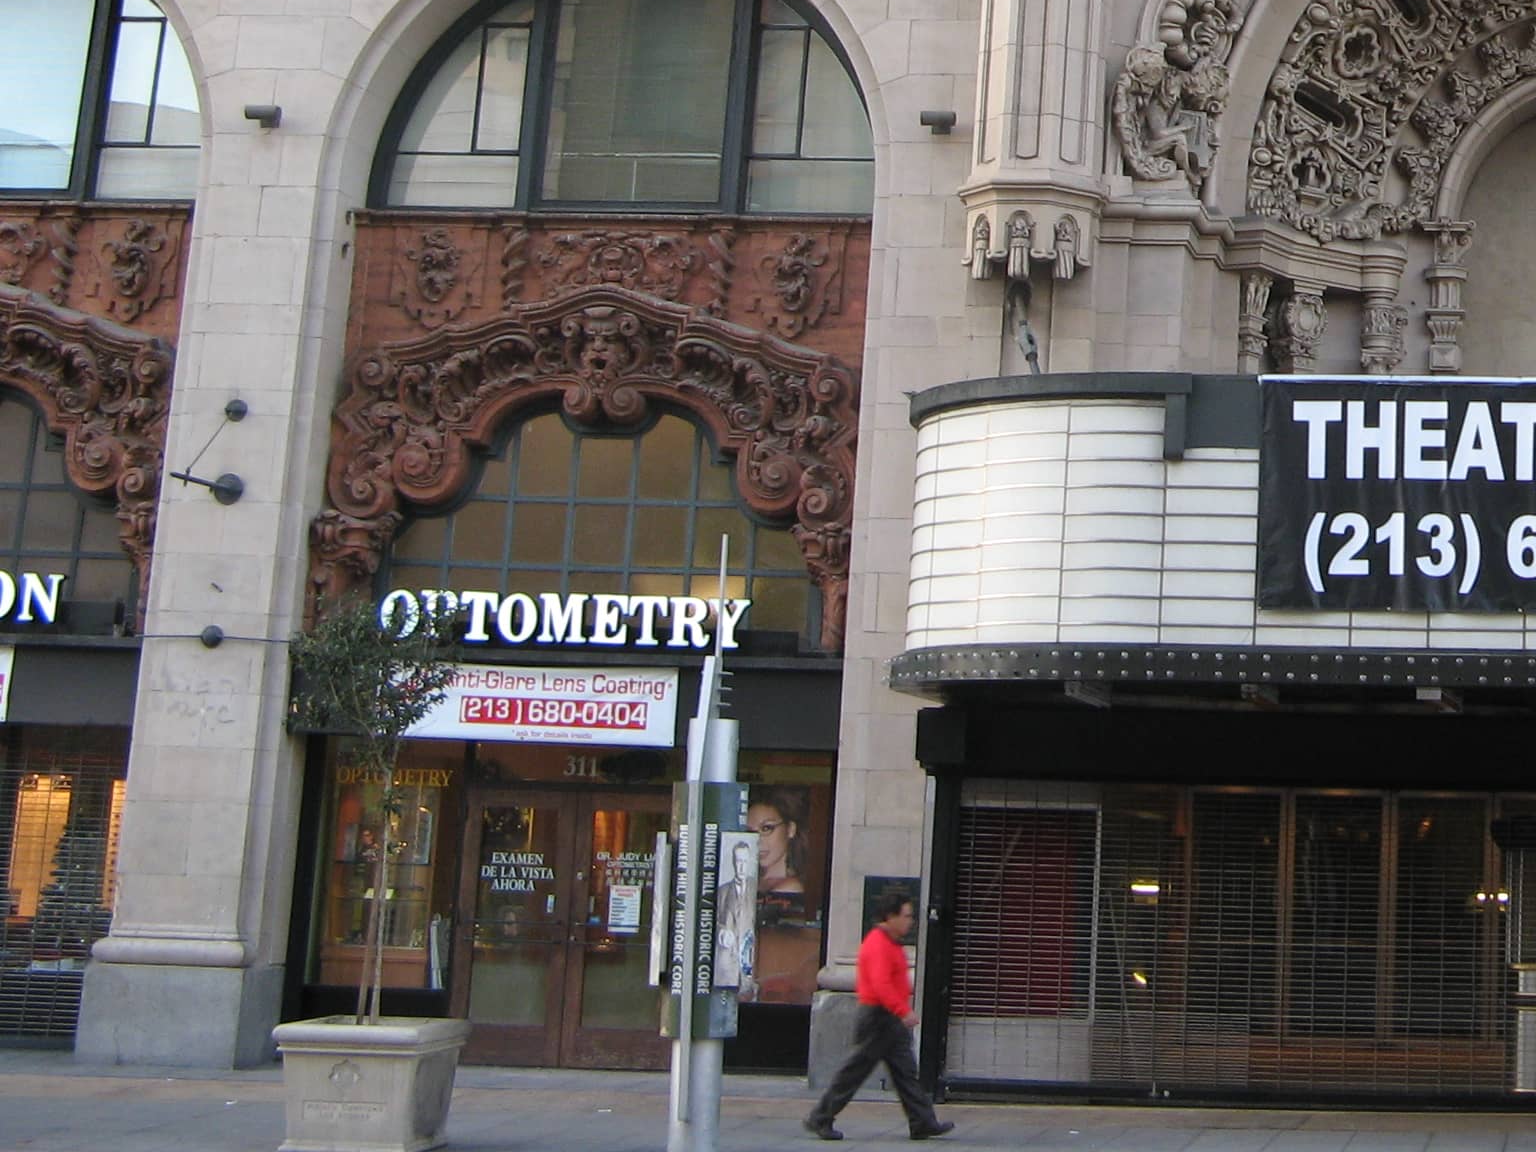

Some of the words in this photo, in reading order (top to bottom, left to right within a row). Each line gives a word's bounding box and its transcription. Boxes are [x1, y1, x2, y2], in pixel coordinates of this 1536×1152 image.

[1304, 511, 1481, 595] (213)
[379, 588, 752, 649] OPTOMETRY
[440, 668, 536, 691] nti-Glare
[541, 671, 586, 693] Lens
[528, 699, 647, 727] 680-0404
[563, 756, 598, 777] 311
[491, 851, 544, 865] EXAMEN
[678, 824, 689, 870] BUNKER
[703, 823, 718, 869] BUNKER
[481, 865, 498, 878] DE
[500, 866, 517, 879] LA
[521, 866, 554, 879] VISTA
[491, 878, 536, 892] AHORA
[676, 872, 688, 896] HILL
[701, 871, 715, 896] HILL
[673, 909, 687, 962] HISTORIC
[698, 908, 713, 962] HISTORIC
[671, 964, 683, 995] CORE
[696, 964, 711, 995] CORE
